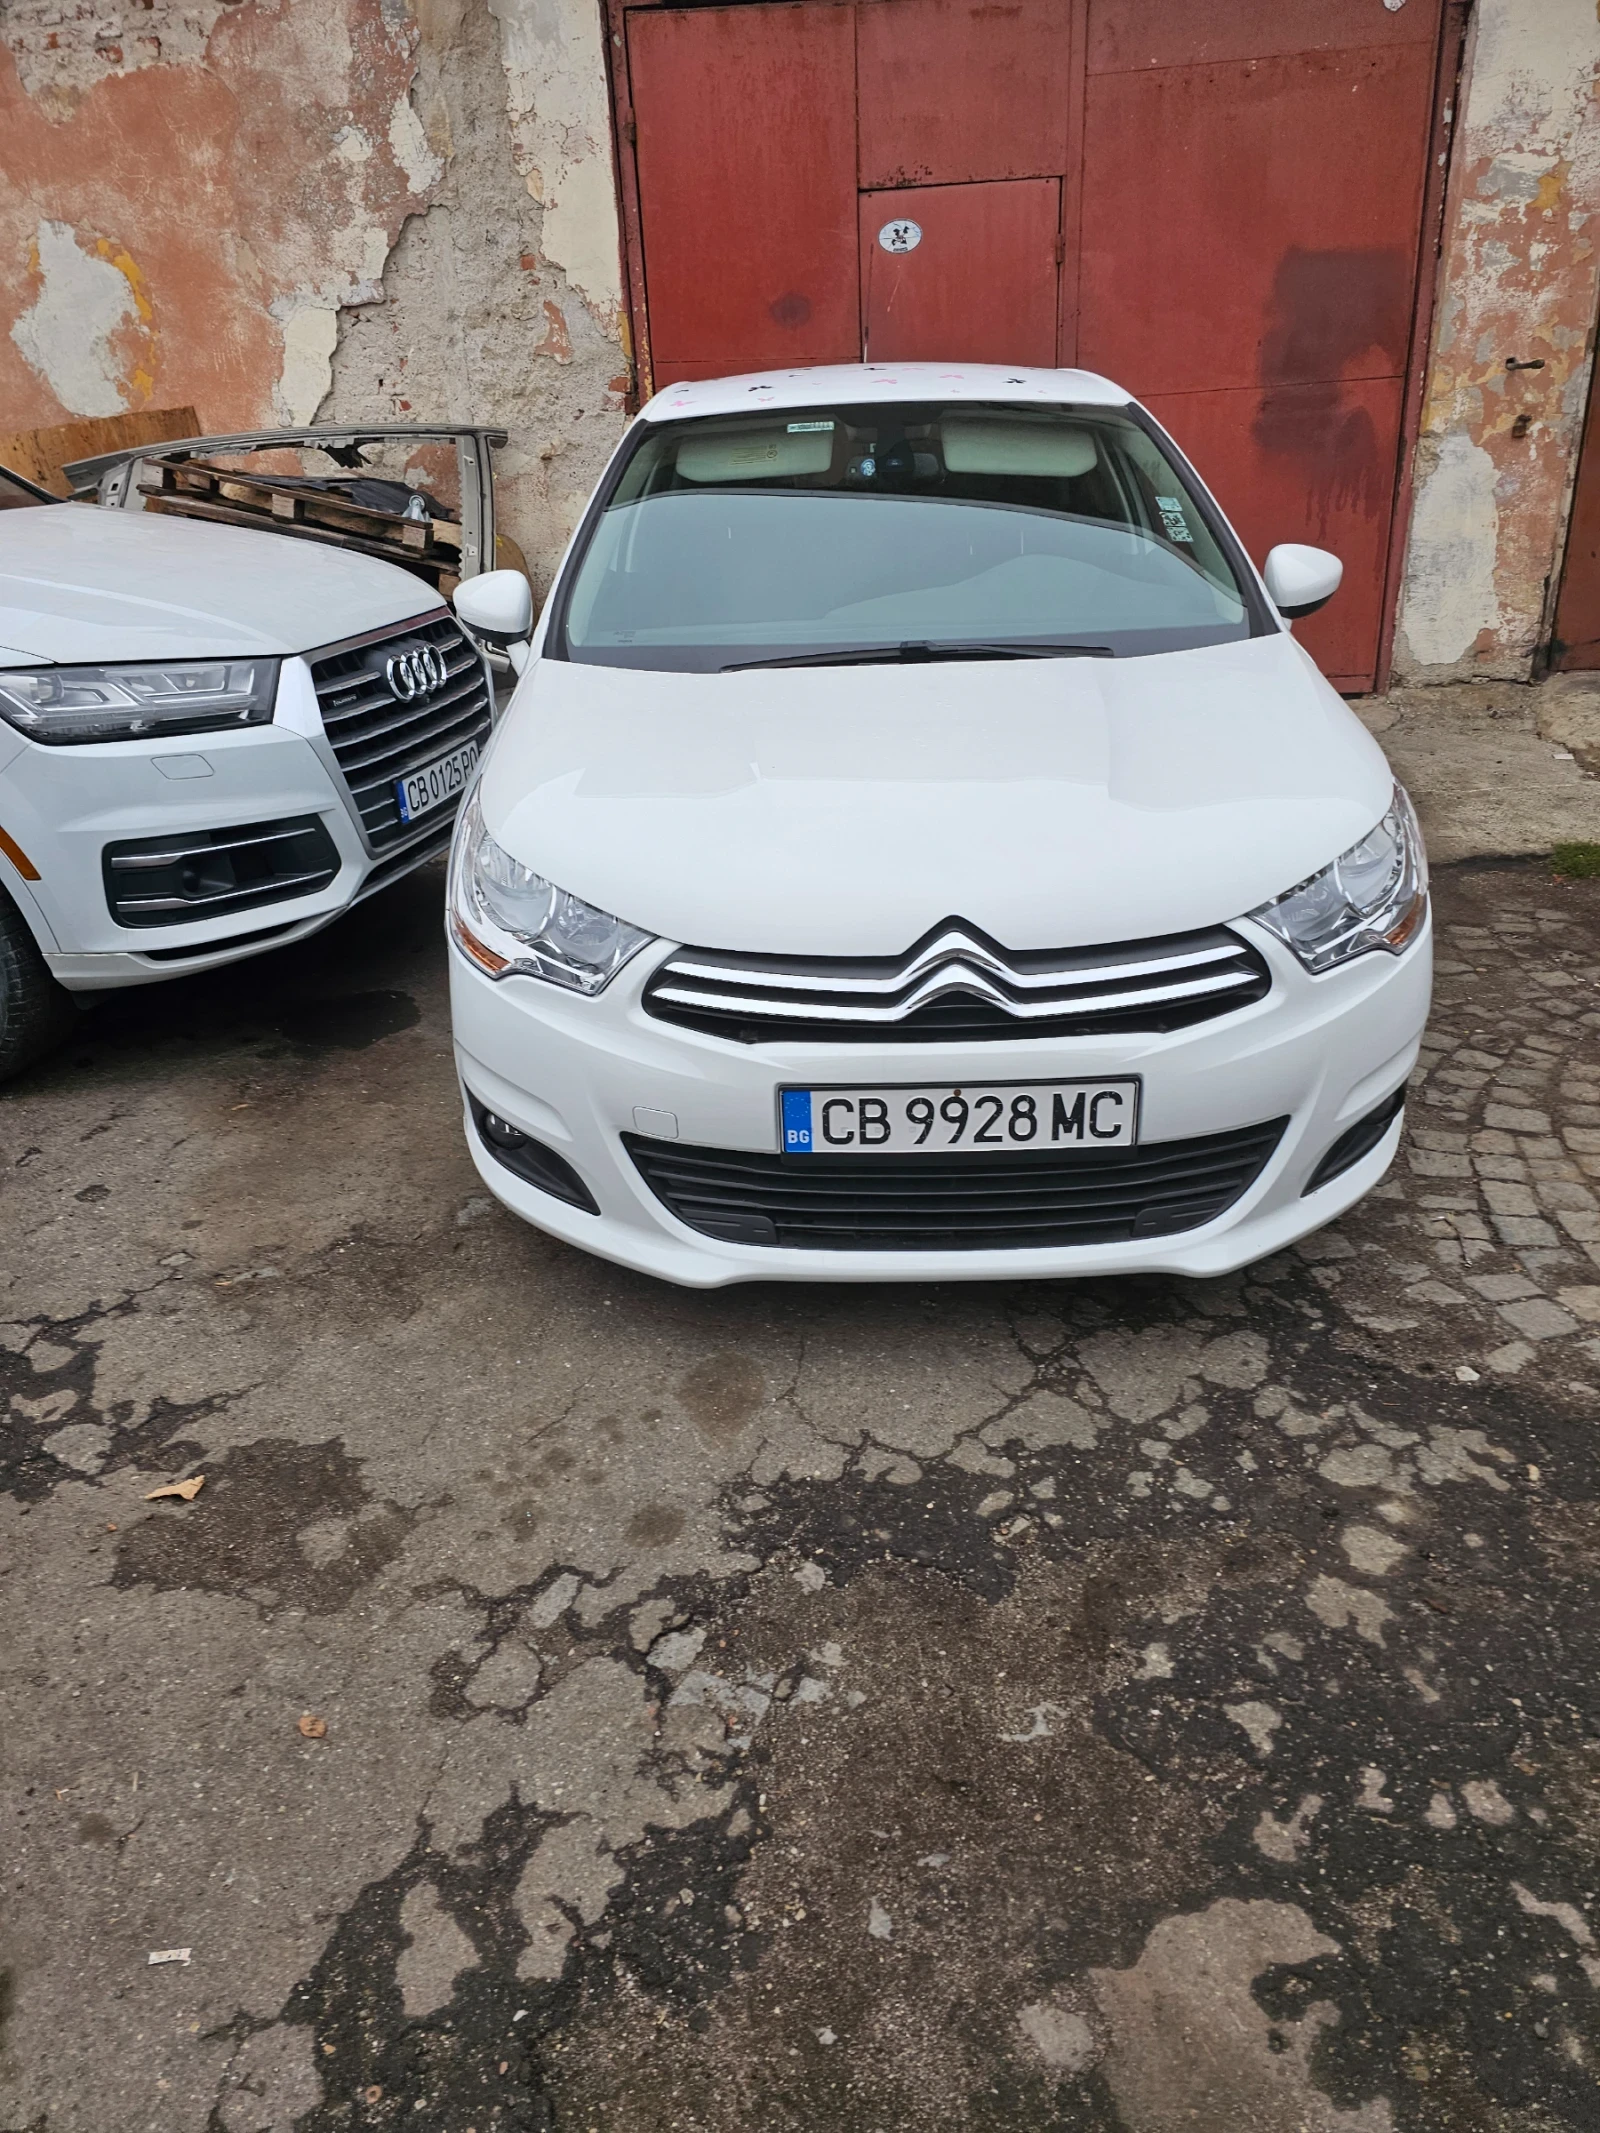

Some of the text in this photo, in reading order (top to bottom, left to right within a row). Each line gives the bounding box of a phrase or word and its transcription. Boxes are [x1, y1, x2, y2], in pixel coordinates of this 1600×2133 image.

[408, 776, 429, 811] CB
[430, 756, 461, 799] 0125
[787, 1130, 810, 1144] BG
[822, 1090, 1123, 1145] CB 9928 MC
